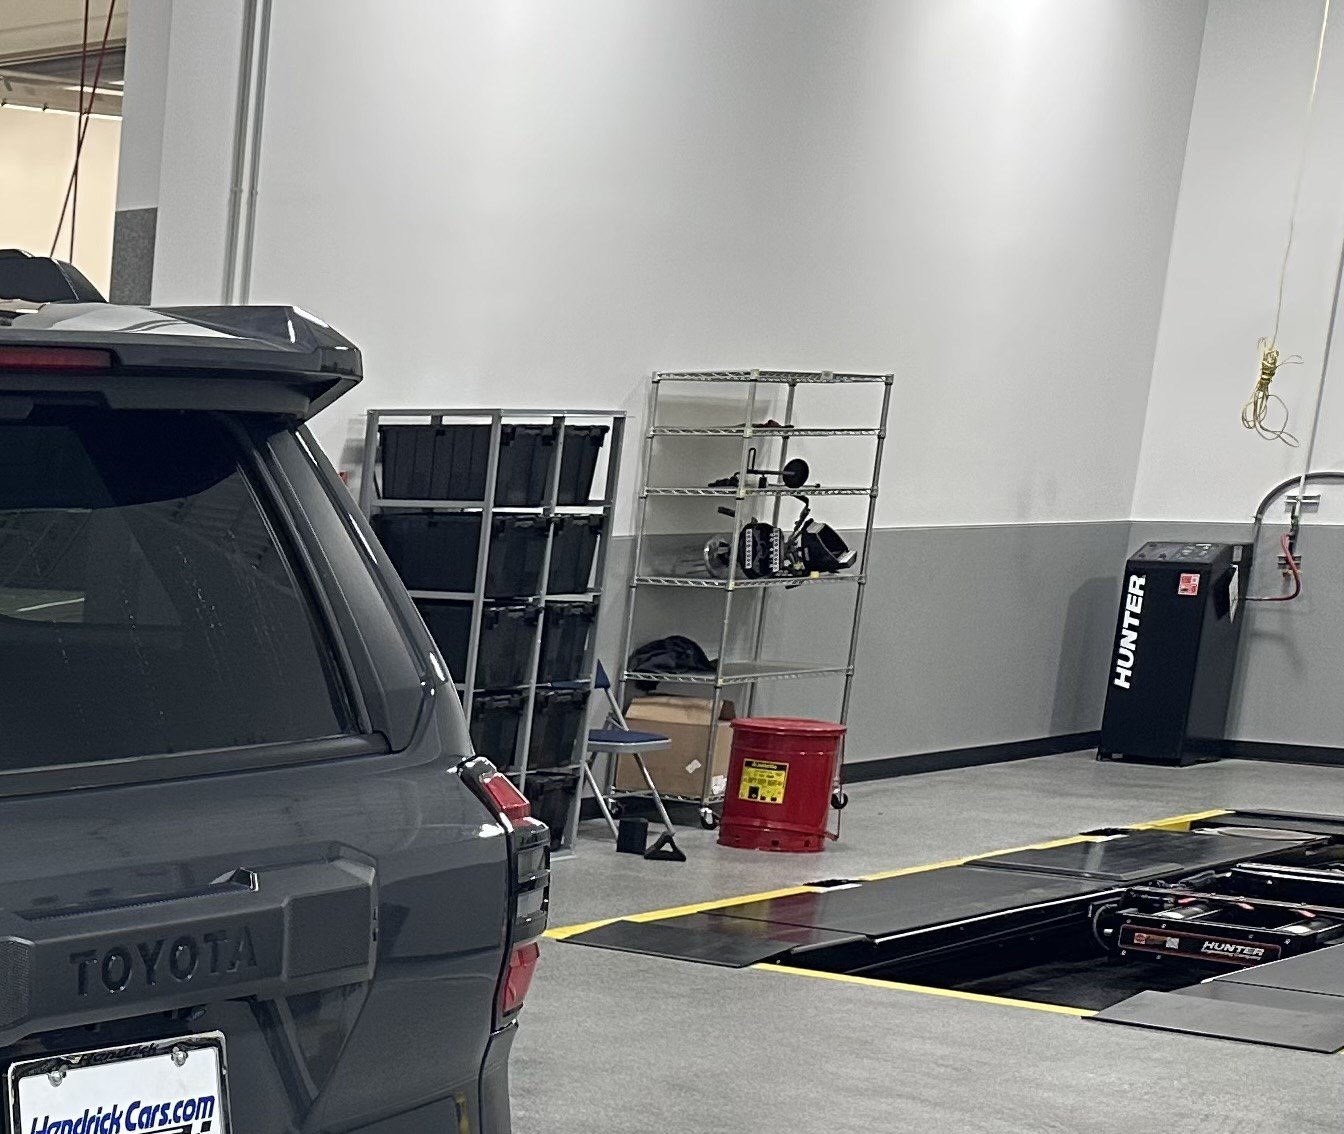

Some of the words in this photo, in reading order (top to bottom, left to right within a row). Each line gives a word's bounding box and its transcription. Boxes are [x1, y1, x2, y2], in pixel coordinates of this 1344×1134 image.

[1114, 574, 1146, 689] HUNTER
[69, 925, 257, 997] TOYOTA
[1202, 940, 1265, 957] HUNTER
